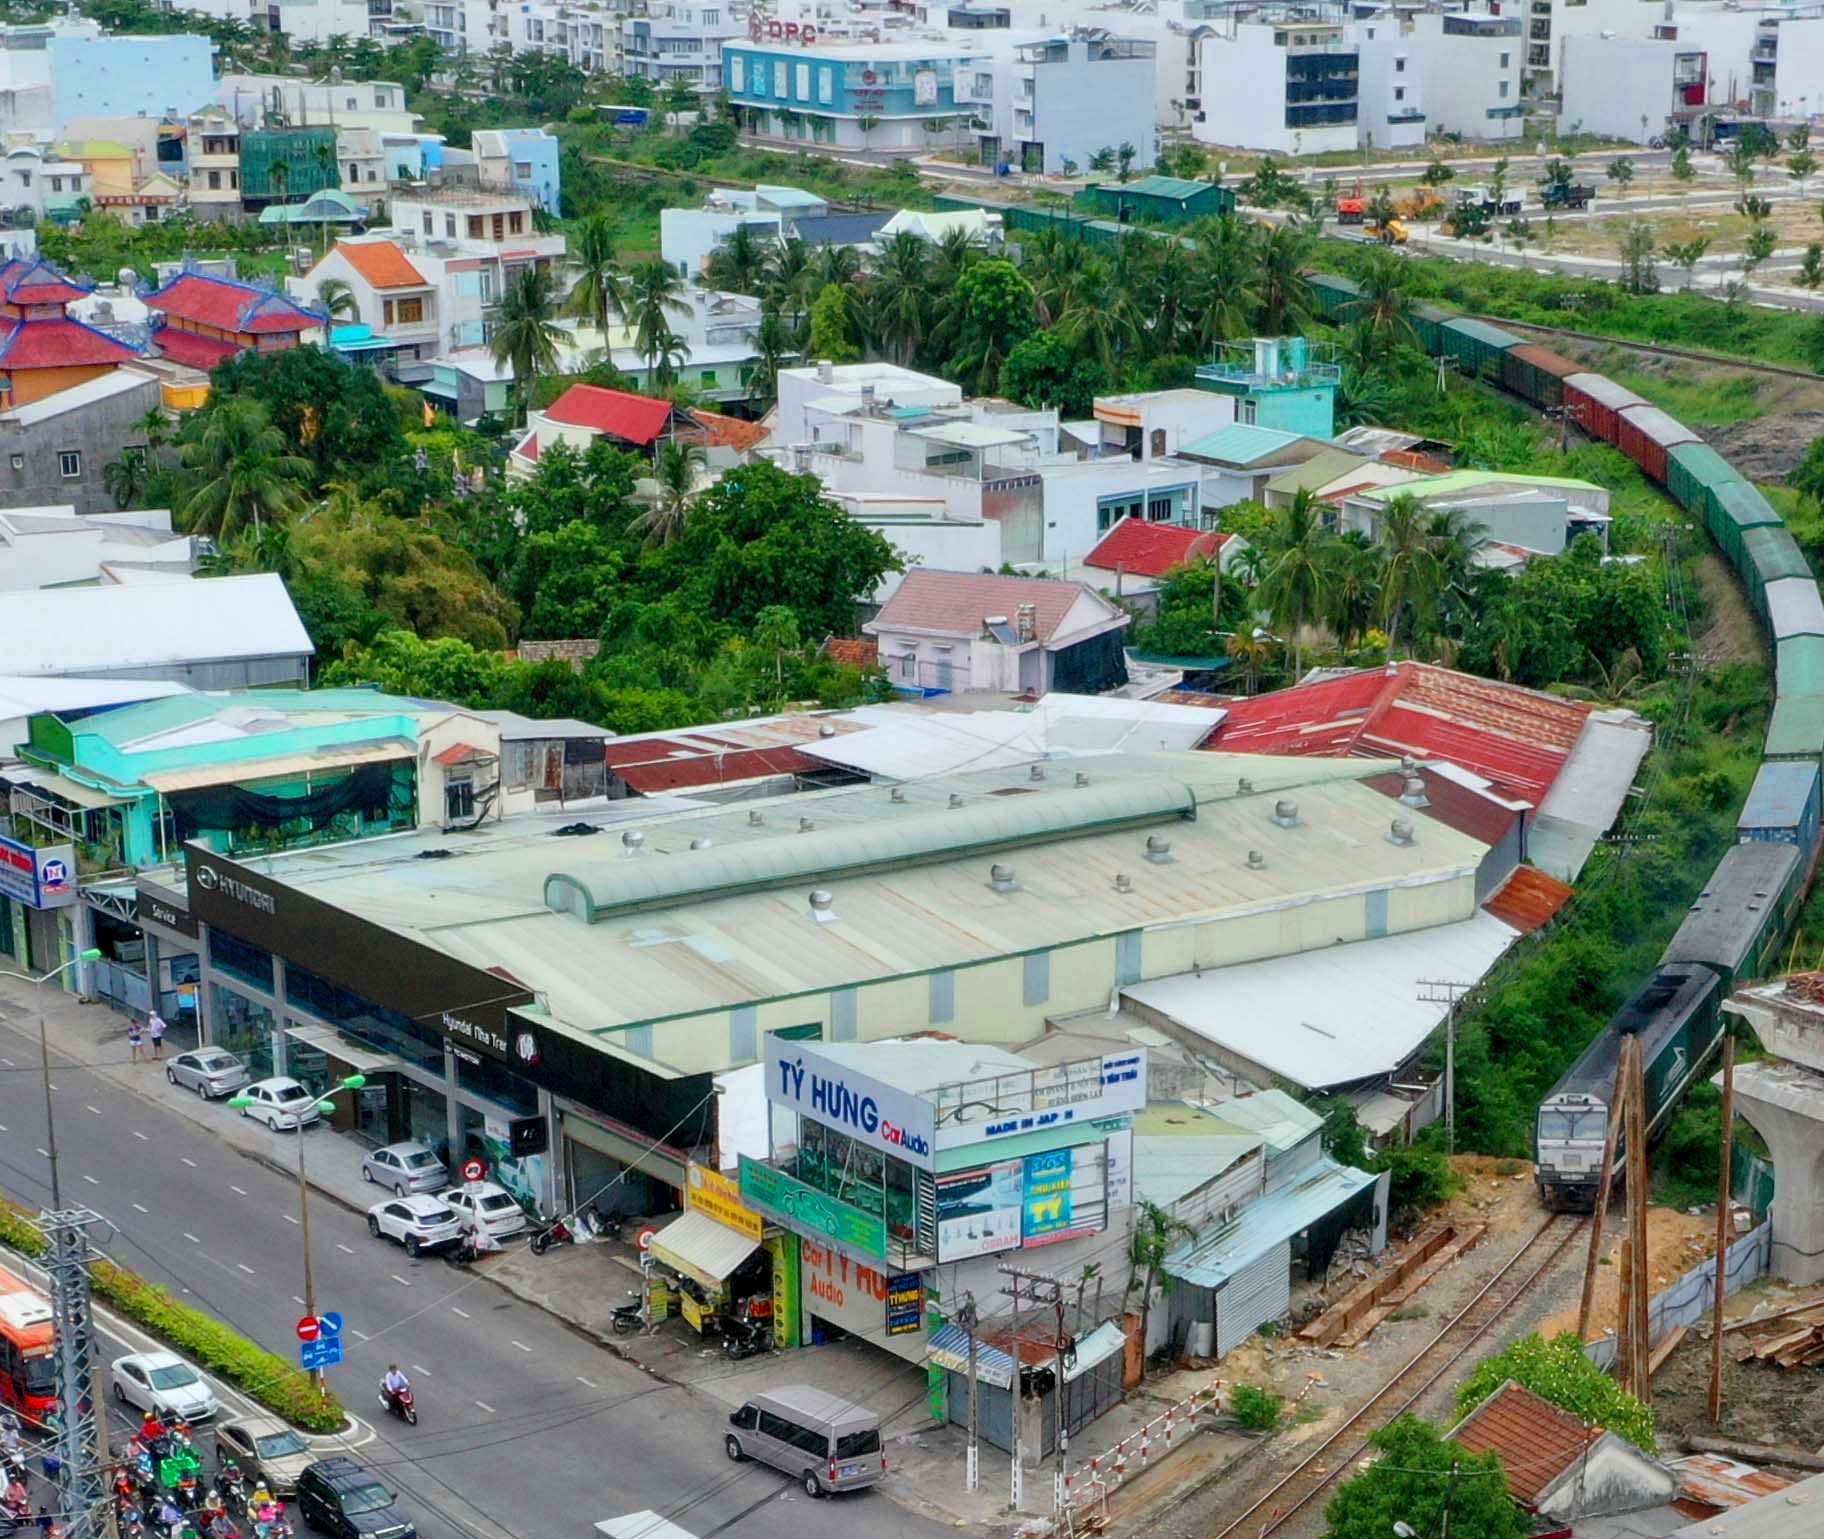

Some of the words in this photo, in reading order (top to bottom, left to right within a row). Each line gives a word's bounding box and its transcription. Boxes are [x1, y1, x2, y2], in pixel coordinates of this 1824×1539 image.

[152, 904, 176, 925] Service
[779, 1057, 805, 1101] TÝ
[811, 1073, 879, 1134] HƯNG
[985, 1120, 1018, 1137] MADE
[1021, 1118, 1034, 1129] IN
[809, 1272, 844, 1307] Audio
